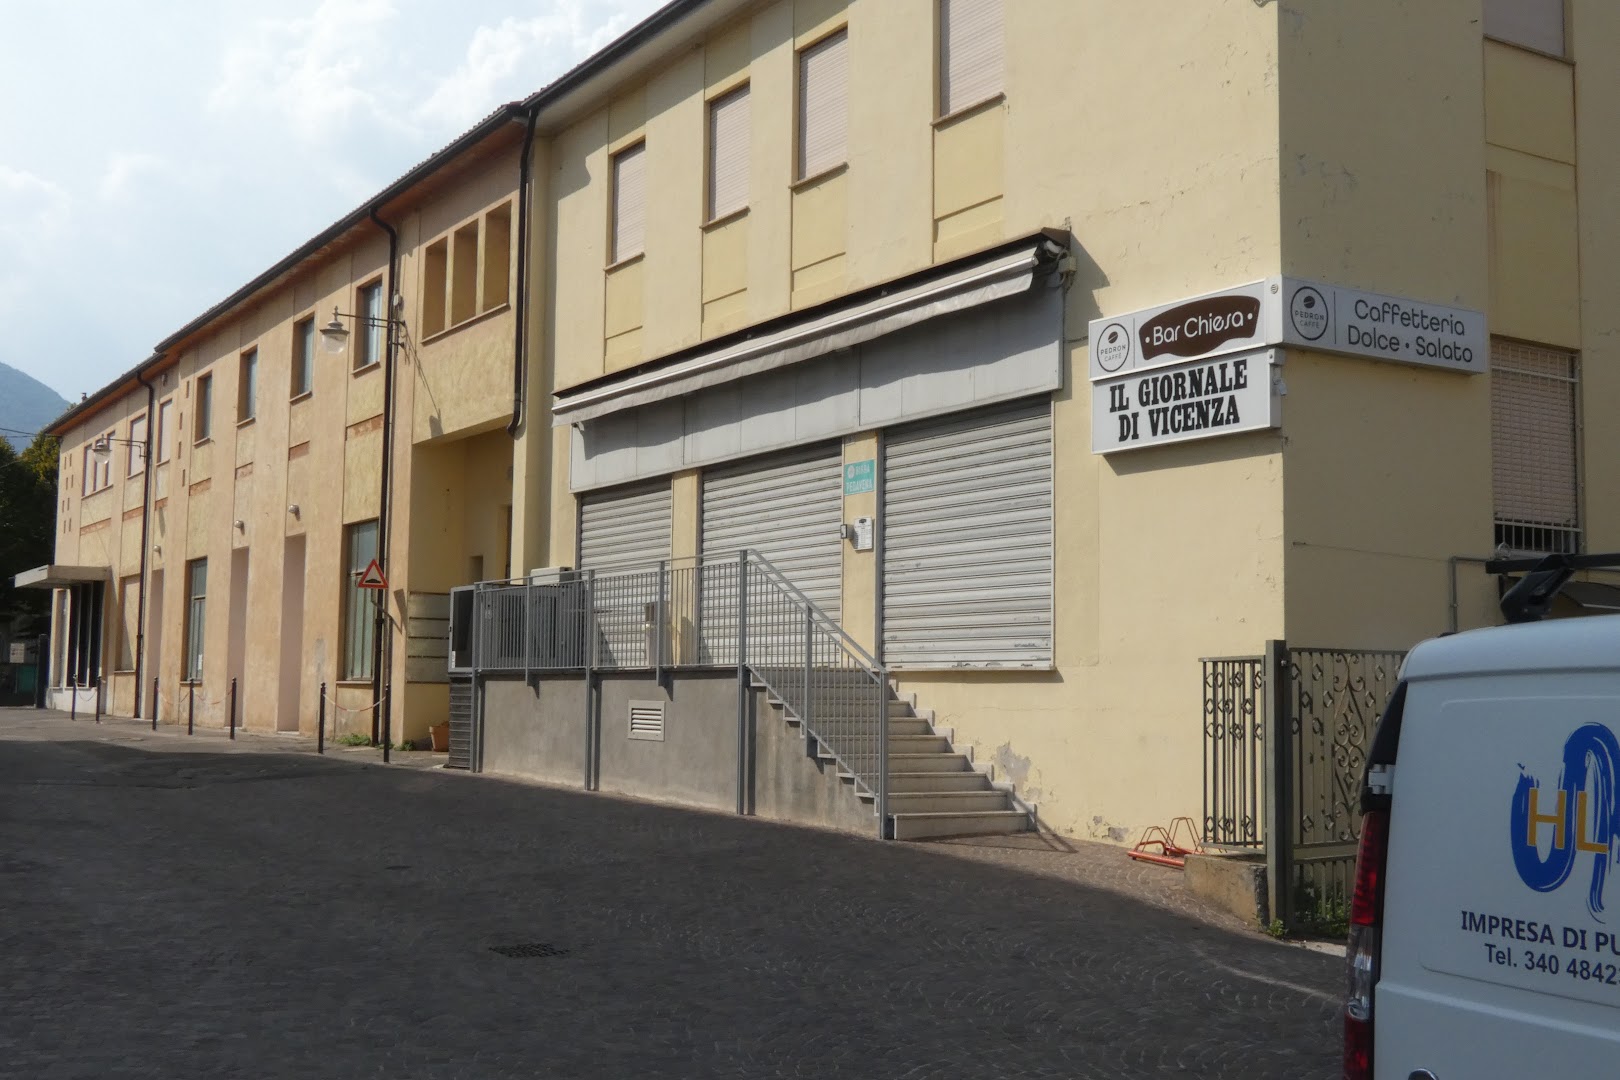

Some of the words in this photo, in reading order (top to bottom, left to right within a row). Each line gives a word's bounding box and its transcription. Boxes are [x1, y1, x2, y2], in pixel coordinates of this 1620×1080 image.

[1153, 325, 1180, 346] Bar
[1184, 311, 1244, 338] Chiesa
[1294, 310, 1324, 320] PEDRON
[1354, 299, 1465, 336] Caffetteria
[1100, 344, 1126, 355] PEDRON
[1348, 325, 1400, 352] Dolce
[1415, 335, 1473, 363] Salato
[1109, 383, 1129, 413] IL
[1138, 358, 1247, 407] GIORNALE
[1118, 412, 1139, 442] DI
[1148, 395, 1240, 437] VICENZA
[1461, 910, 1555, 946] IMPRESA
[1563, 927, 1587, 950] DI
[1484, 943, 1517, 967] Tel.
[1524, 950, 1559, 974] 340
[1566, 957, 1620, 985] 4842
